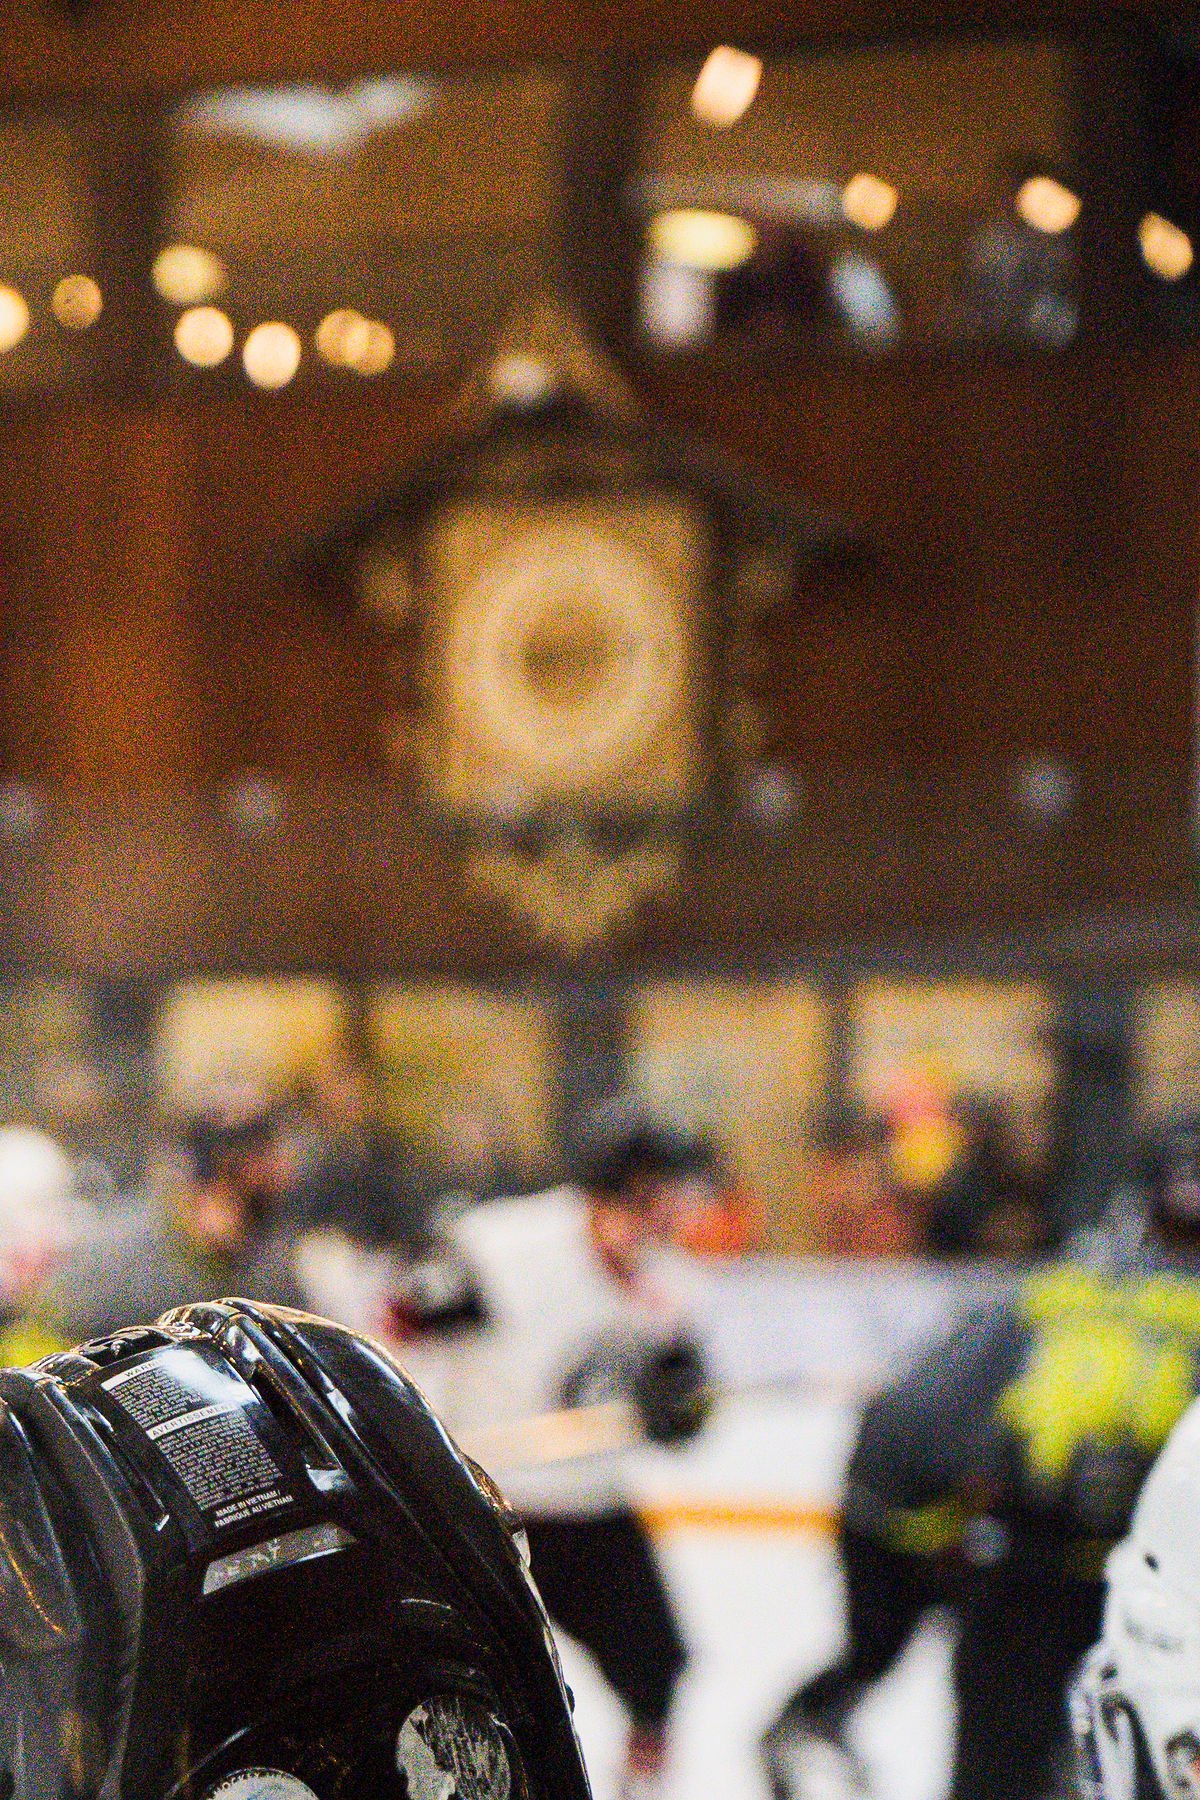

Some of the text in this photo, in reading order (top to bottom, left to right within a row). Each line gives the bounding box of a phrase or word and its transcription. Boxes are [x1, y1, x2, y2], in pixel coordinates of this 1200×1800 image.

[214, 1494, 295, 1529] FABRIQUE AU VIETNAM
[215, 1503, 239, 1518] MADE
[237, 1500, 248, 1510] IN
[245, 1489, 278, 1506] VIETNAM
